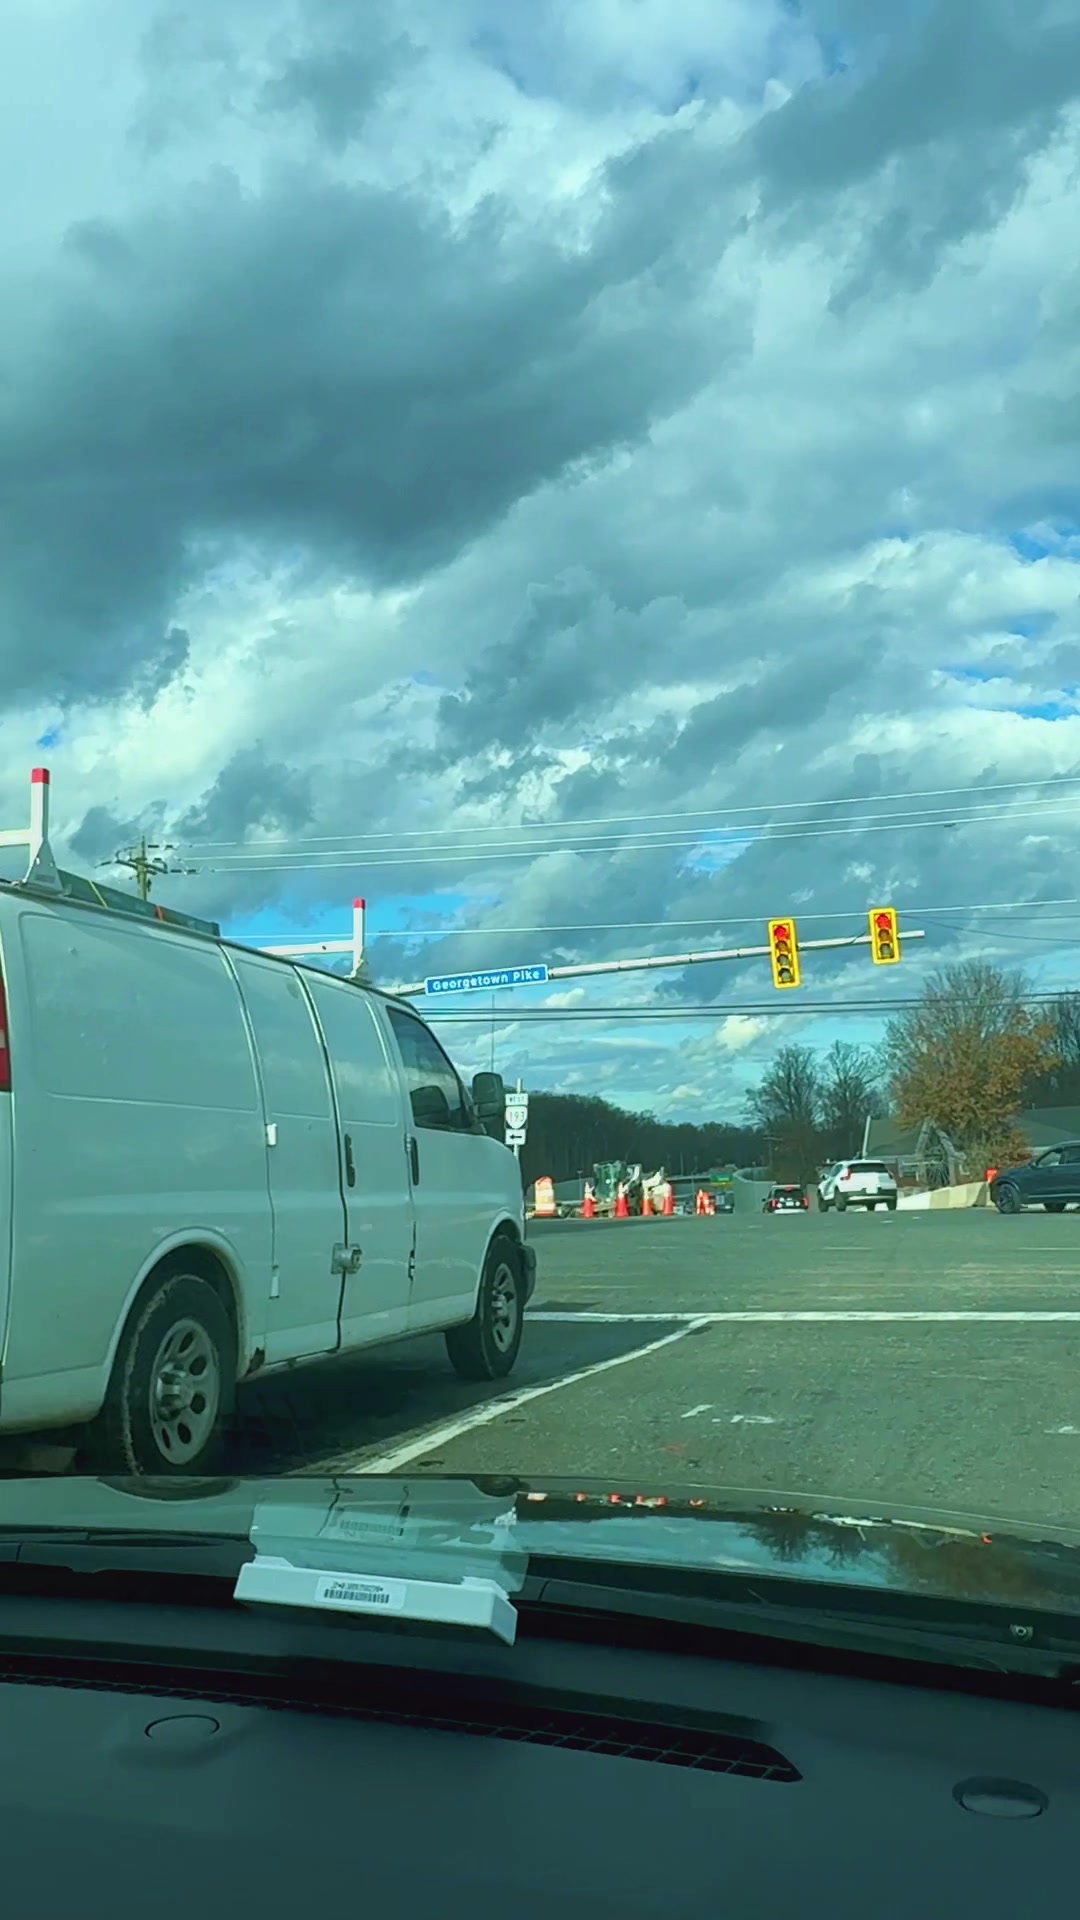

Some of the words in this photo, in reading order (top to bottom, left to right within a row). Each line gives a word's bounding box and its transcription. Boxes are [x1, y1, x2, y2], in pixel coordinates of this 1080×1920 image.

[432, 973, 509, 991] Georgetown
[513, 968, 540, 982] Pike
[509, 1111, 525, 1122] 193
